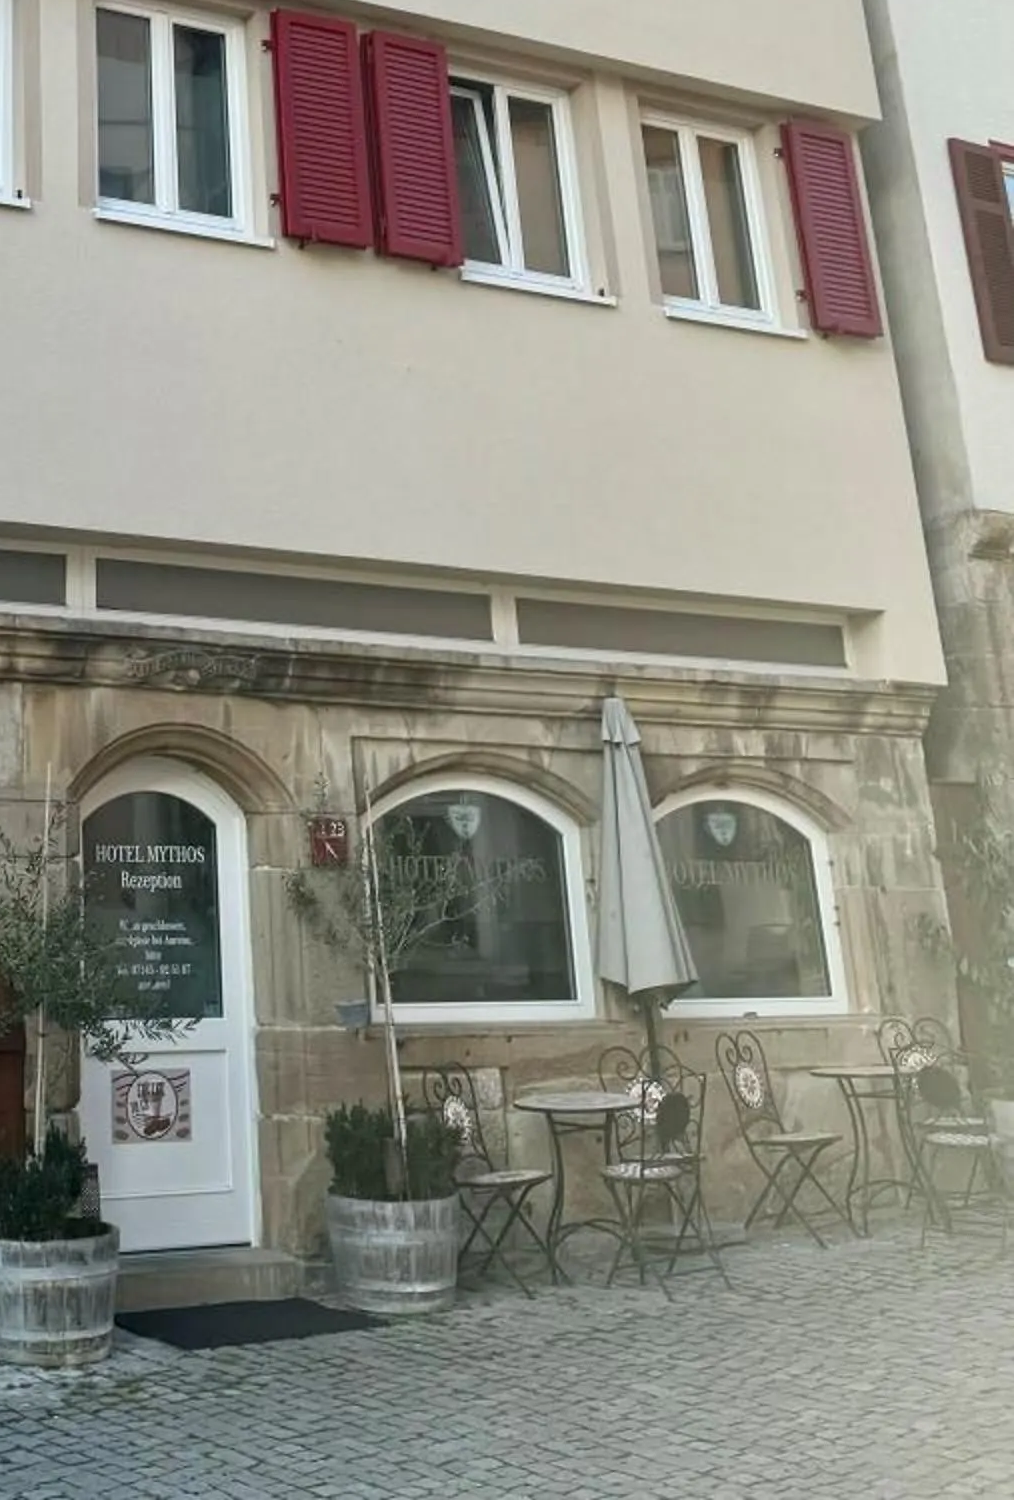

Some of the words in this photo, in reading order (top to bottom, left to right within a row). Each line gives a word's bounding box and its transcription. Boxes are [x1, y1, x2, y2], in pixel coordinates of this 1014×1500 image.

[95, 843, 145, 863] HOTEL
[147, 844, 206, 863] MYTHOS
[121, 870, 183, 893] Rezeption
